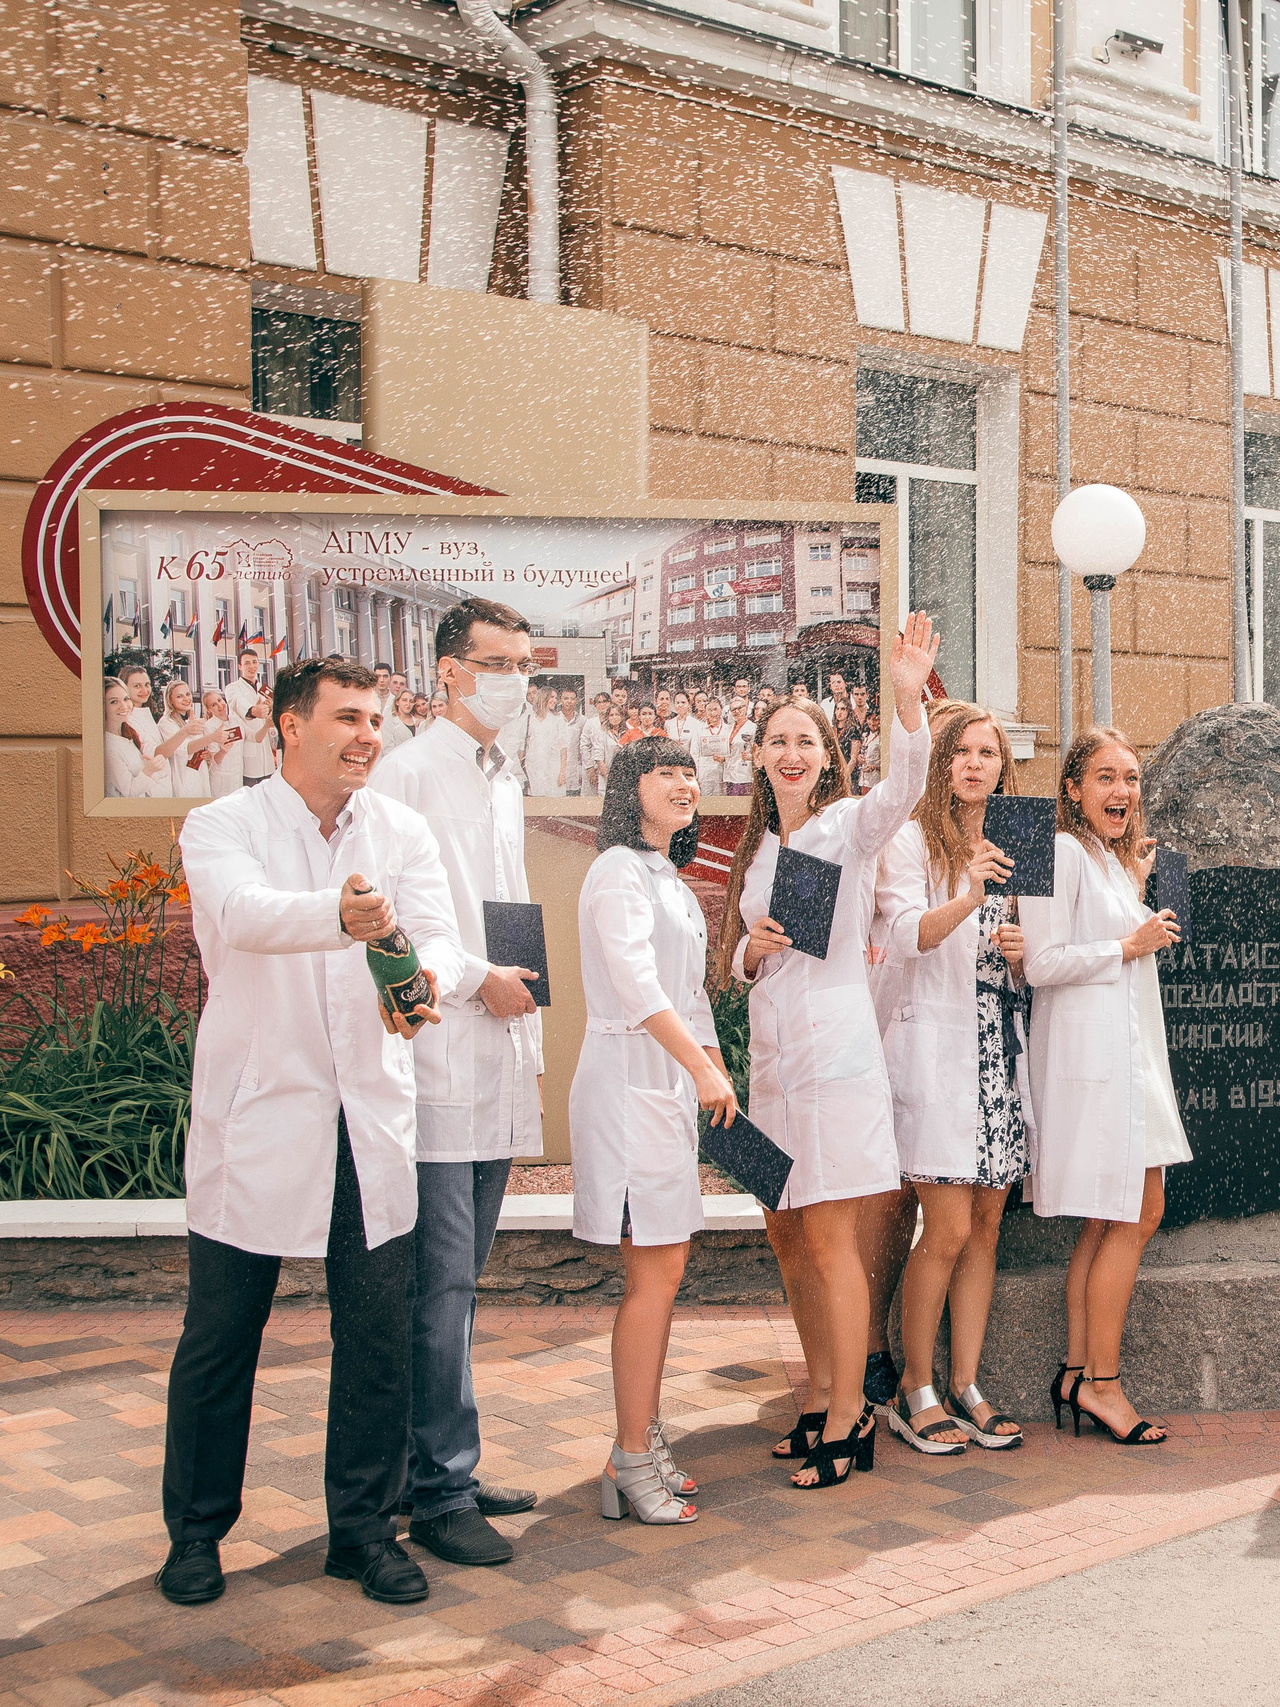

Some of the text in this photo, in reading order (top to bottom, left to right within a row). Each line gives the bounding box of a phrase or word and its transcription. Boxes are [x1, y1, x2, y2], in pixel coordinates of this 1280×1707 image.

[322, 531, 413, 555] АГМУ
[440, 541, 486, 560] вуз,
[322, 561, 630, 589] устремленный в будущее!
[1166, 1021, 1264, 1050] ЦИНСКИЙ
